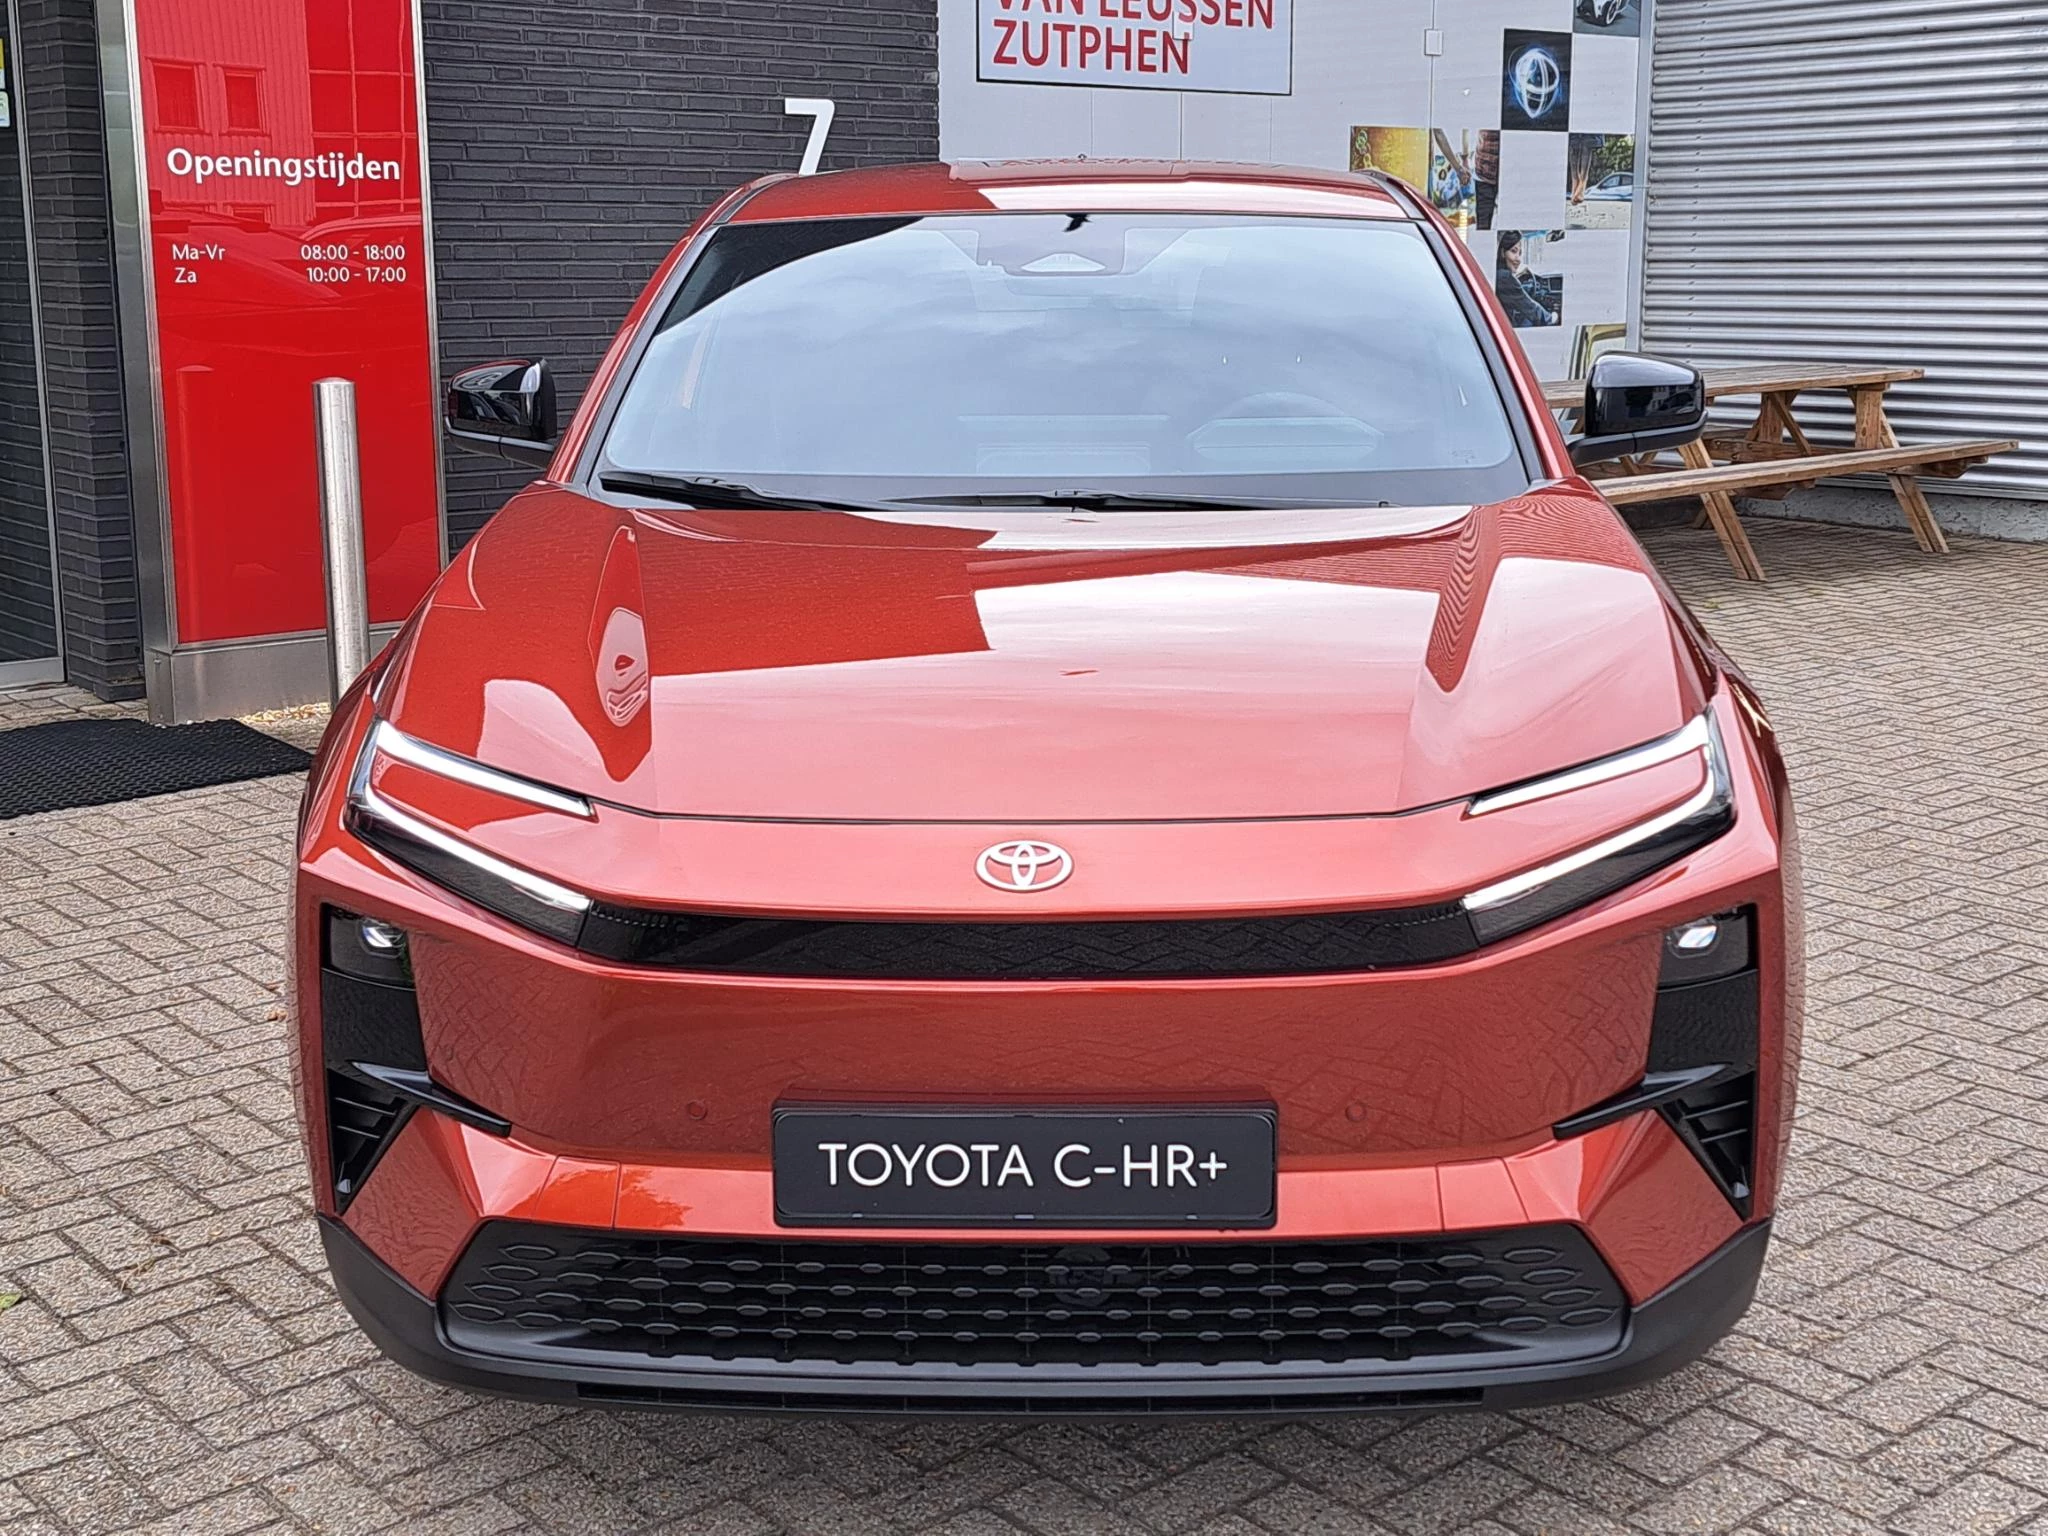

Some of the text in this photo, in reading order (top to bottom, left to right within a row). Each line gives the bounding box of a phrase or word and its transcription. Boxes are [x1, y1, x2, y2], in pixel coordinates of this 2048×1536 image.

[993, 19, 1188, 74] ZUTPHEN
[784, 97, 836, 176] 7
[166, 147, 401, 187] Openingstijden
[172, 243, 226, 261] Ma-Vr
[300, 244, 349, 261] 08:00
[363, 244, 406, 261] 18:00
[174, 266, 198, 283] Za
[306, 266, 350, 283] 10:00
[365, 266, 407, 283] 17:00
[817, 1143, 1228, 1188] TOYOTA C-HR+
